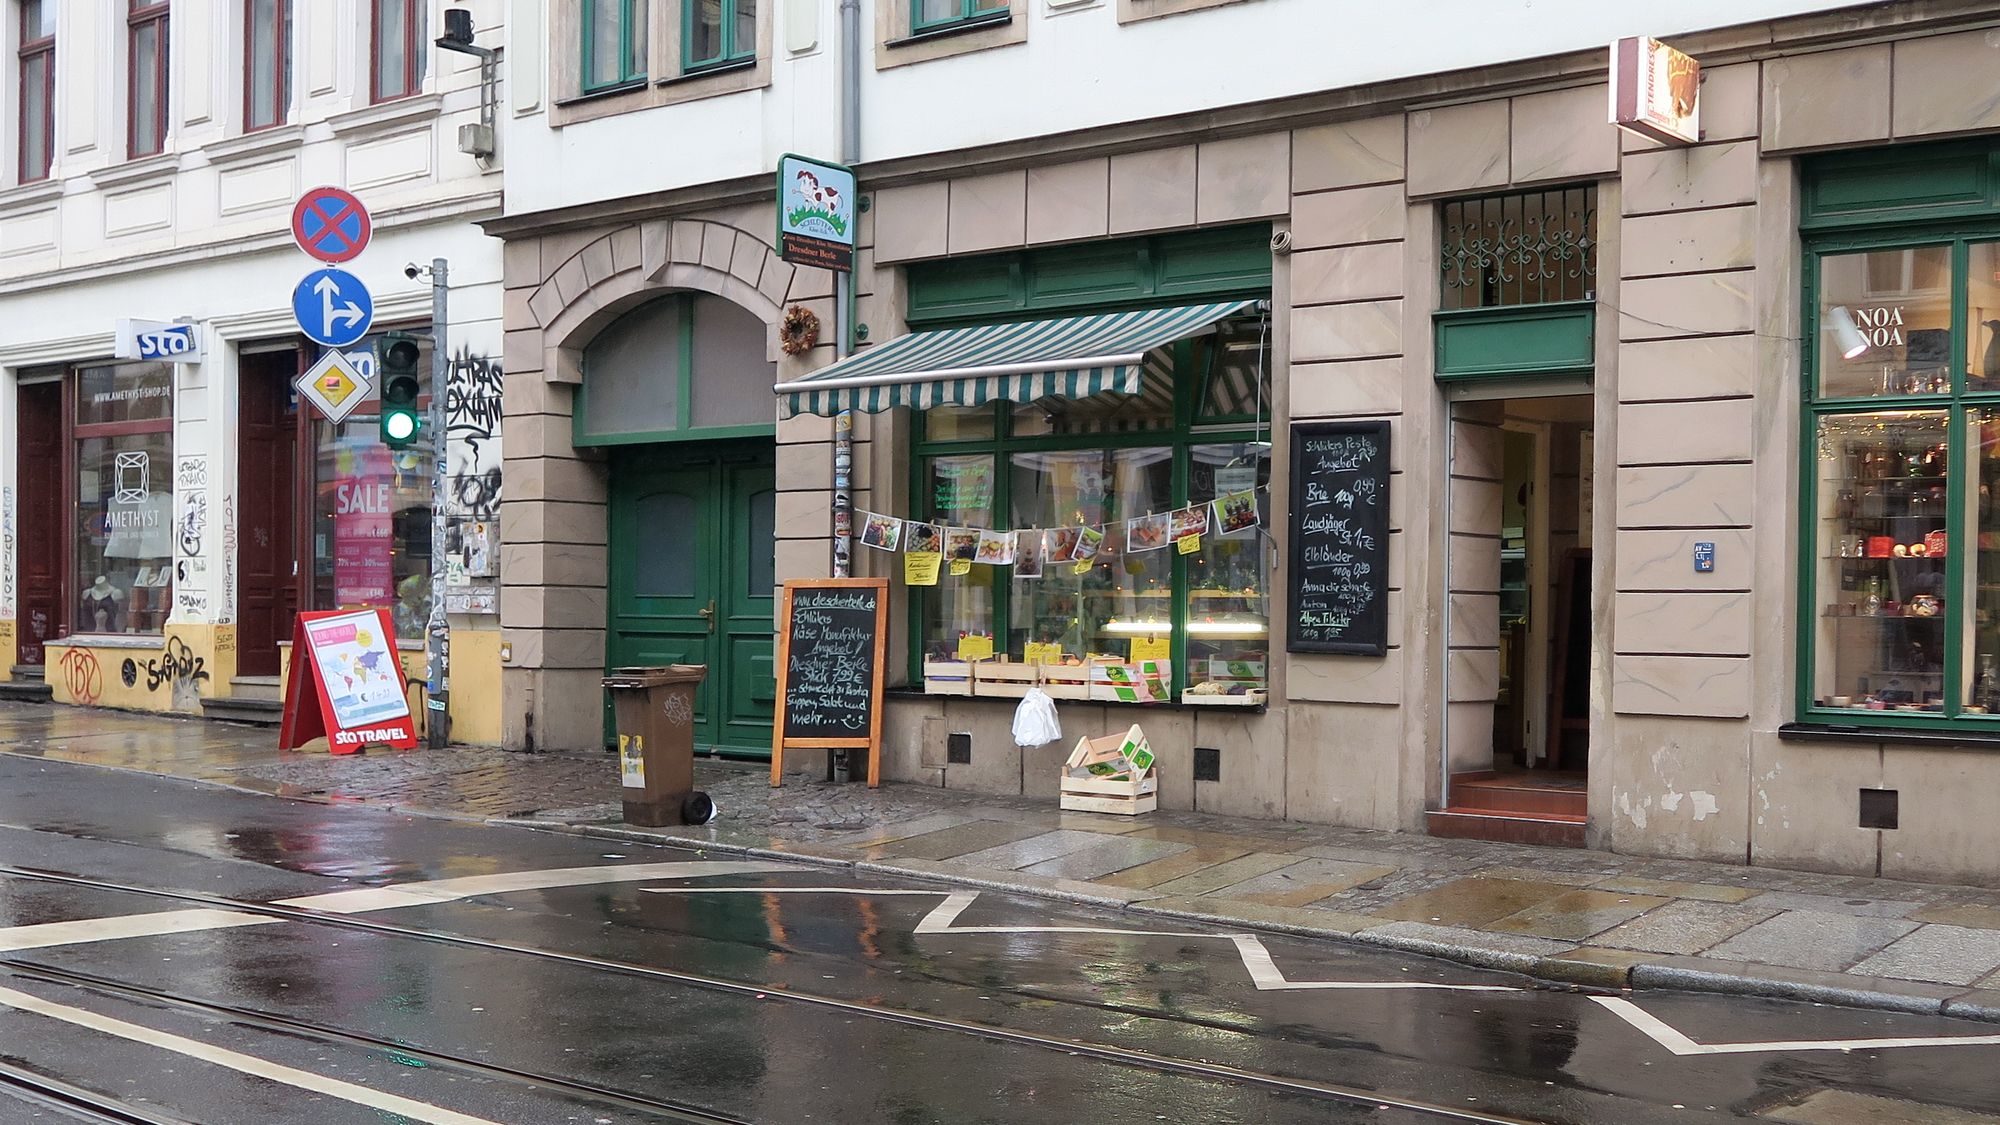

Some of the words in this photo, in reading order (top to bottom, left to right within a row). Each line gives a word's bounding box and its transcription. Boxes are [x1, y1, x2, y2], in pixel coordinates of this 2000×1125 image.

[1856, 307, 1904, 327] NOA
[141, 331, 189, 356] sta
[1856, 327, 1903, 347] NOA
[1317, 454, 1360, 472] Angebot
[337, 484, 389, 514] SALE
[1306, 482, 1330, 501] Brie
[104, 510, 159, 528] AMETHYST
[793, 625, 817, 641] Käse
[820, 625, 872, 642] Manufaktur
[335, 731, 358, 745] sta
[357, 727, 409, 743] TRAVEL
